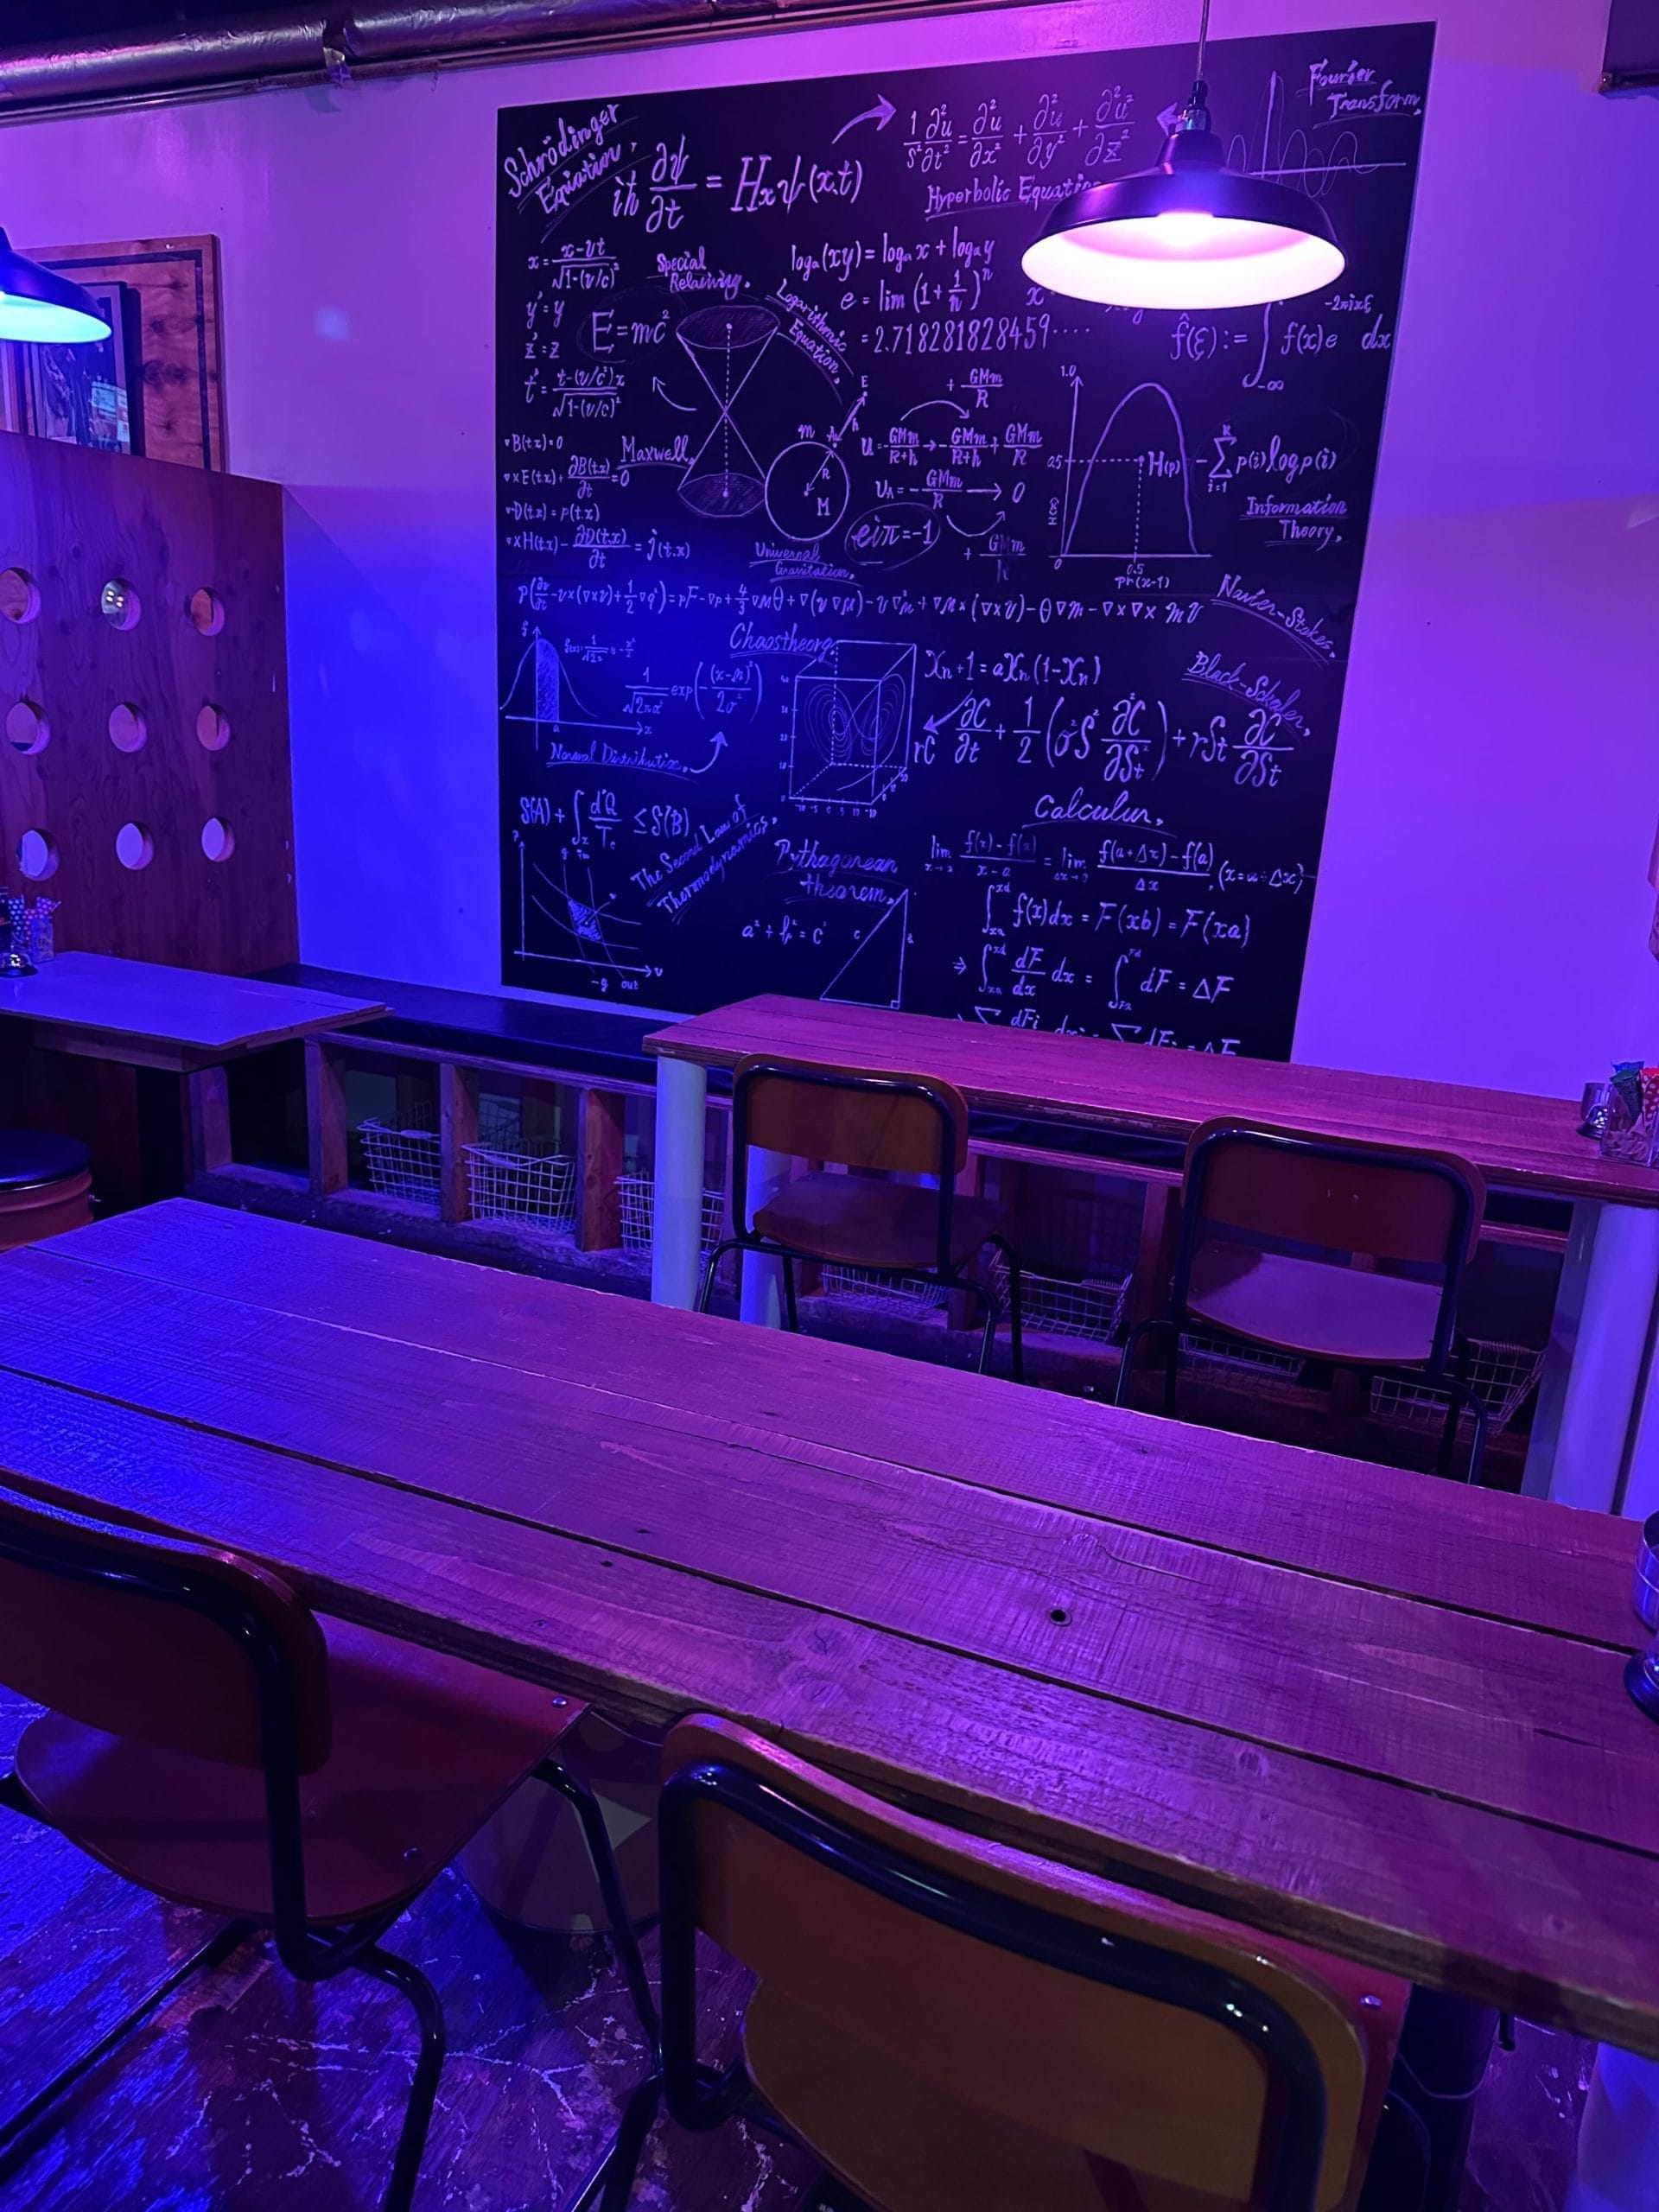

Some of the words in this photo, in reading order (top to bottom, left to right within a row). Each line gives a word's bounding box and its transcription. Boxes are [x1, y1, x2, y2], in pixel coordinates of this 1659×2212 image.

[925, 175, 1011, 213] Hyperbolic
[657, 245, 707, 276] Special
[630, 868, 663, 891] The
